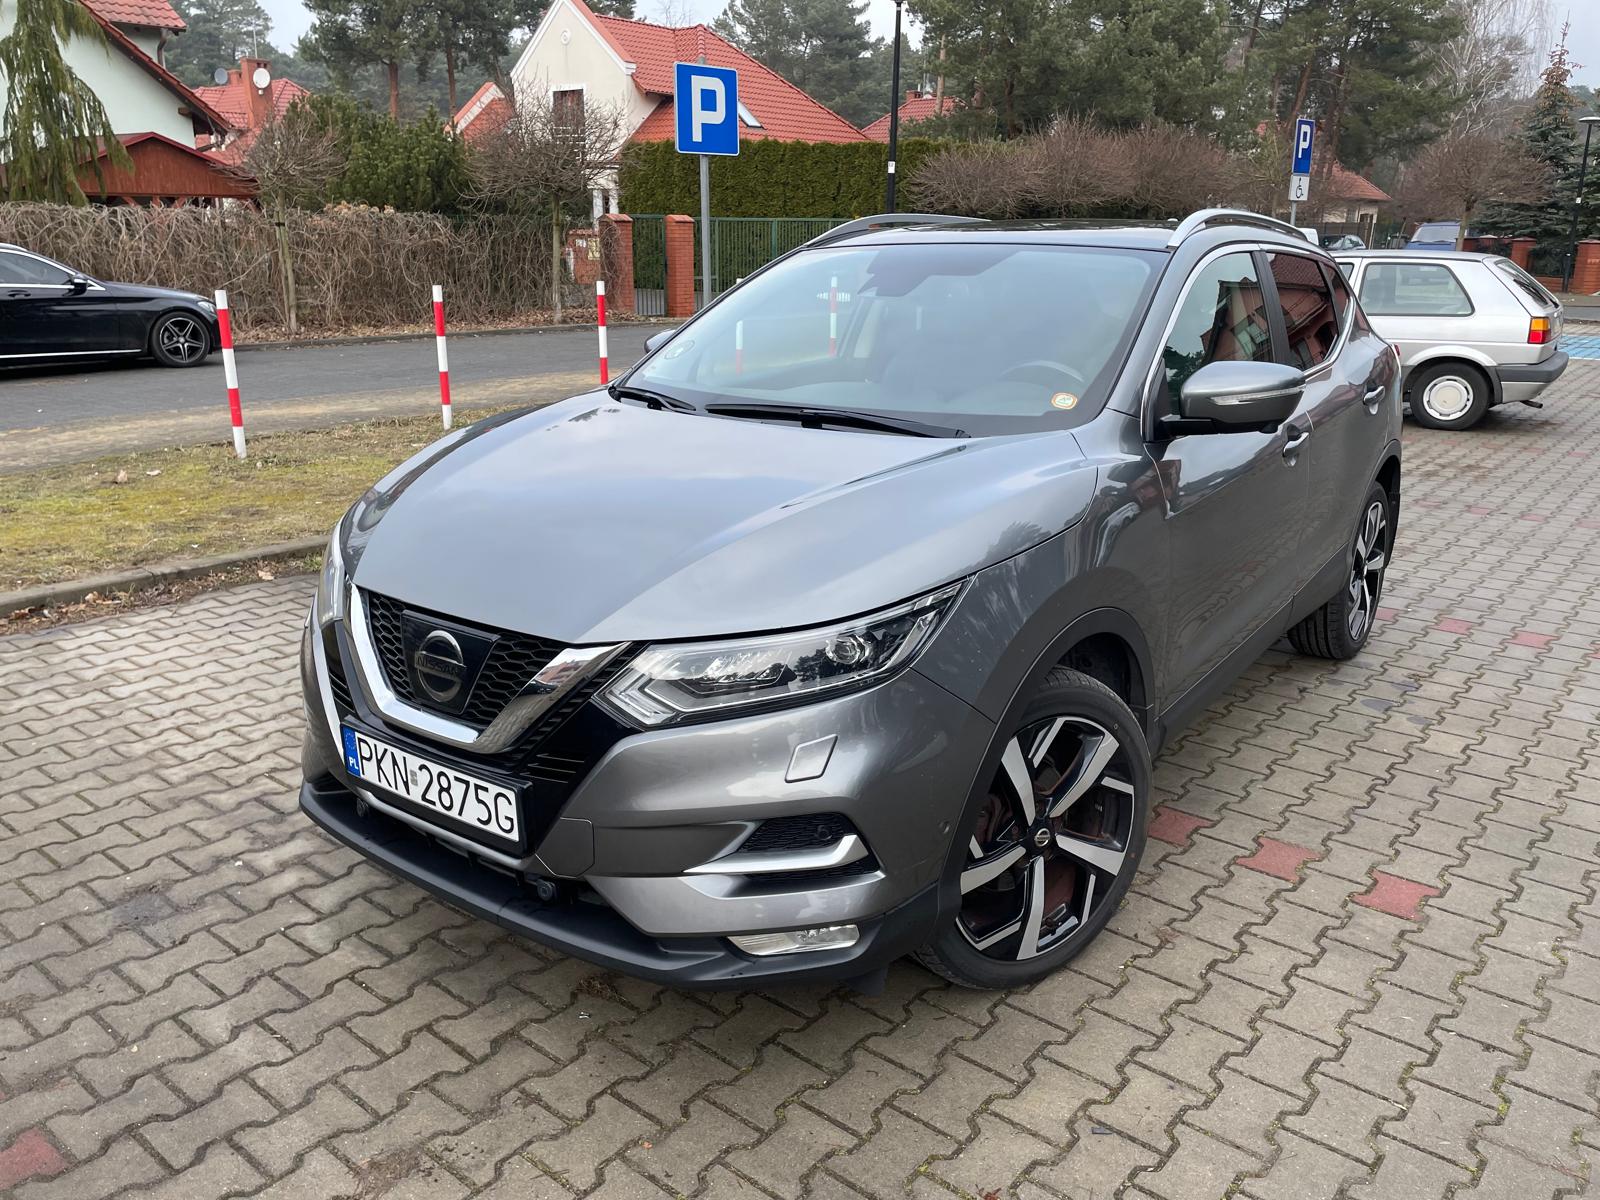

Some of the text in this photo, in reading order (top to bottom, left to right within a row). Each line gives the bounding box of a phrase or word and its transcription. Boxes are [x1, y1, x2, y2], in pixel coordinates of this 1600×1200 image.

[691, 75, 725, 142] P
[1298, 124, 1311, 158] P
[416, 655, 459, 675] NISSAN
[349, 756, 358, 769] PL
[358, 737, 515, 834] PKN 2875G
